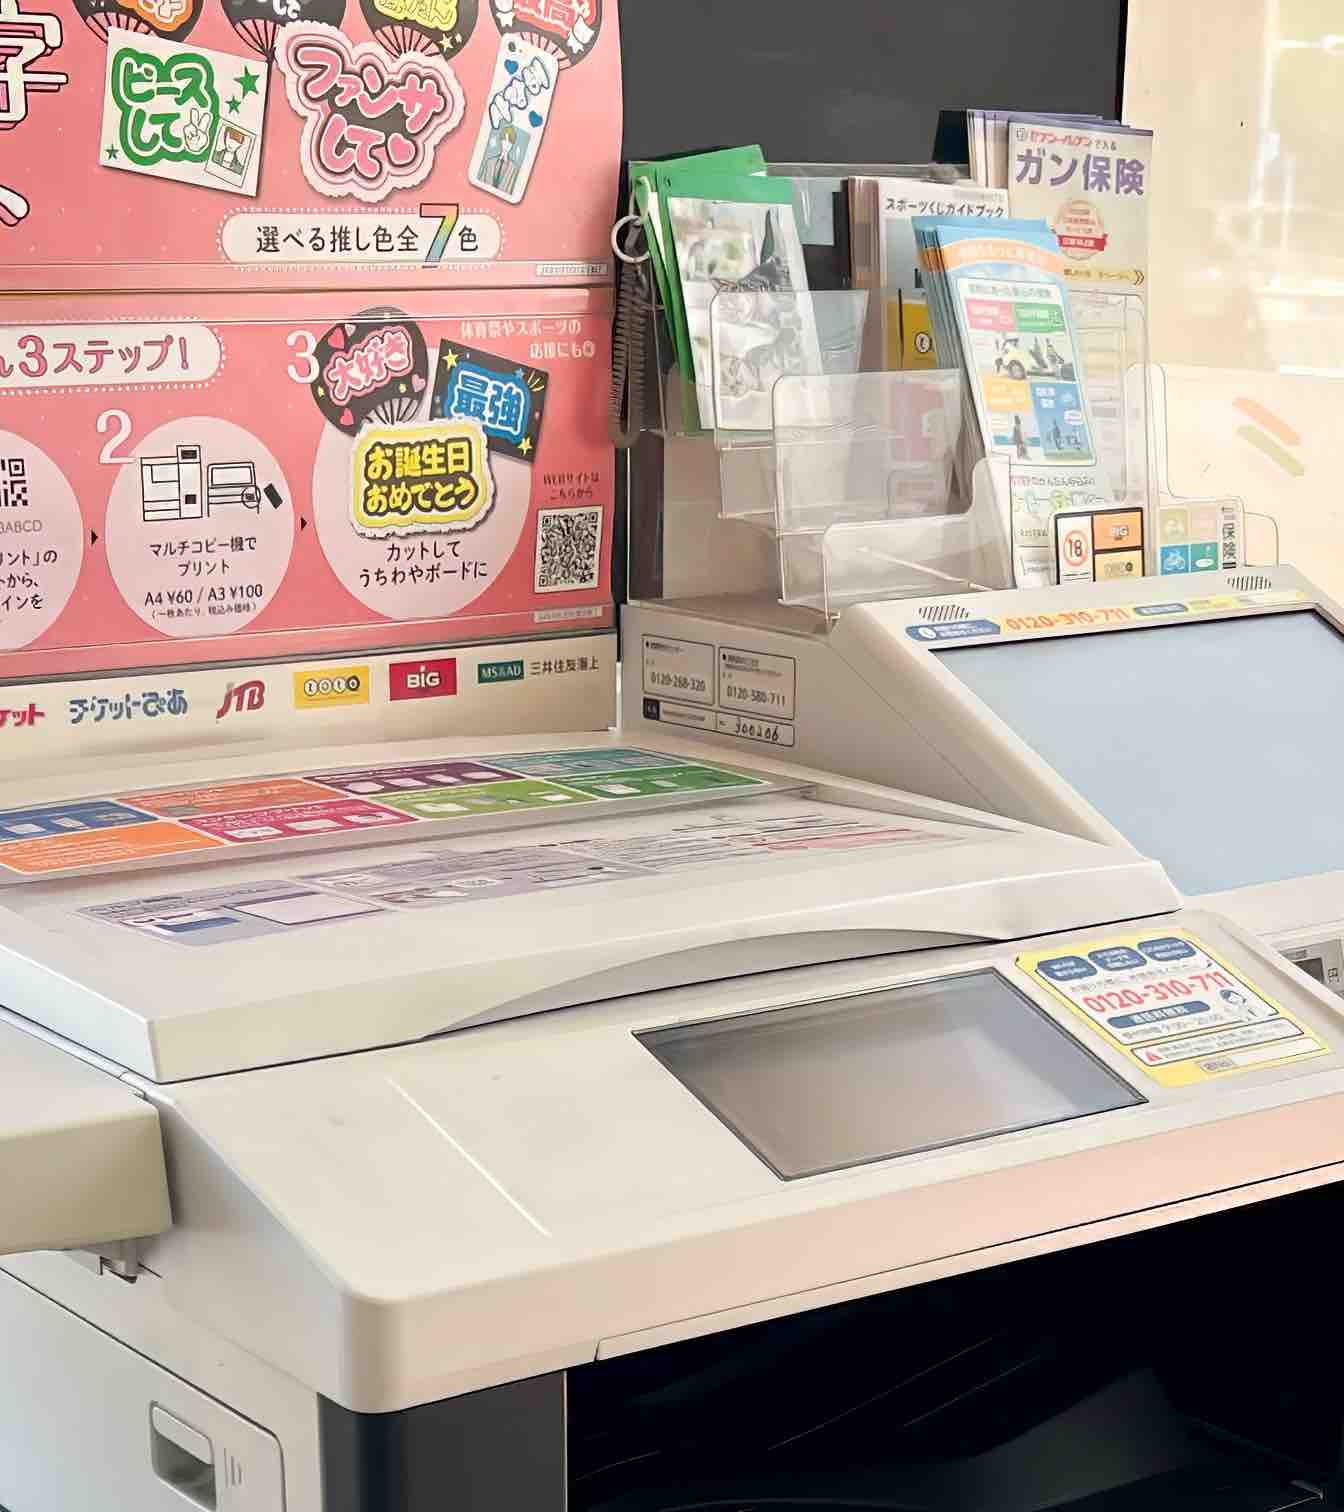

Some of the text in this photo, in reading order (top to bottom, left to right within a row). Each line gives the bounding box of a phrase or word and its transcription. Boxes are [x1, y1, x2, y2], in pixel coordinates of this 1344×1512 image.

[122, 60, 210, 108] ピース
[1015, 147, 1145, 196] ガン保険
[287, 329, 320, 385] 3
[452, 370, 525, 435] 最強
[96, 408, 136, 465] 2
[365, 438, 472, 481] お誕生日
[364, 477, 478, 515] おめでとう
[149, 536, 257, 556] マルチコピー機で
[387, 540, 461, 562] カットして
[177, 560, 231, 576] プリント
[359, 561, 488, 588] うちわやボードに
[1082, 970, 1235, 1014] 0120-310-711
